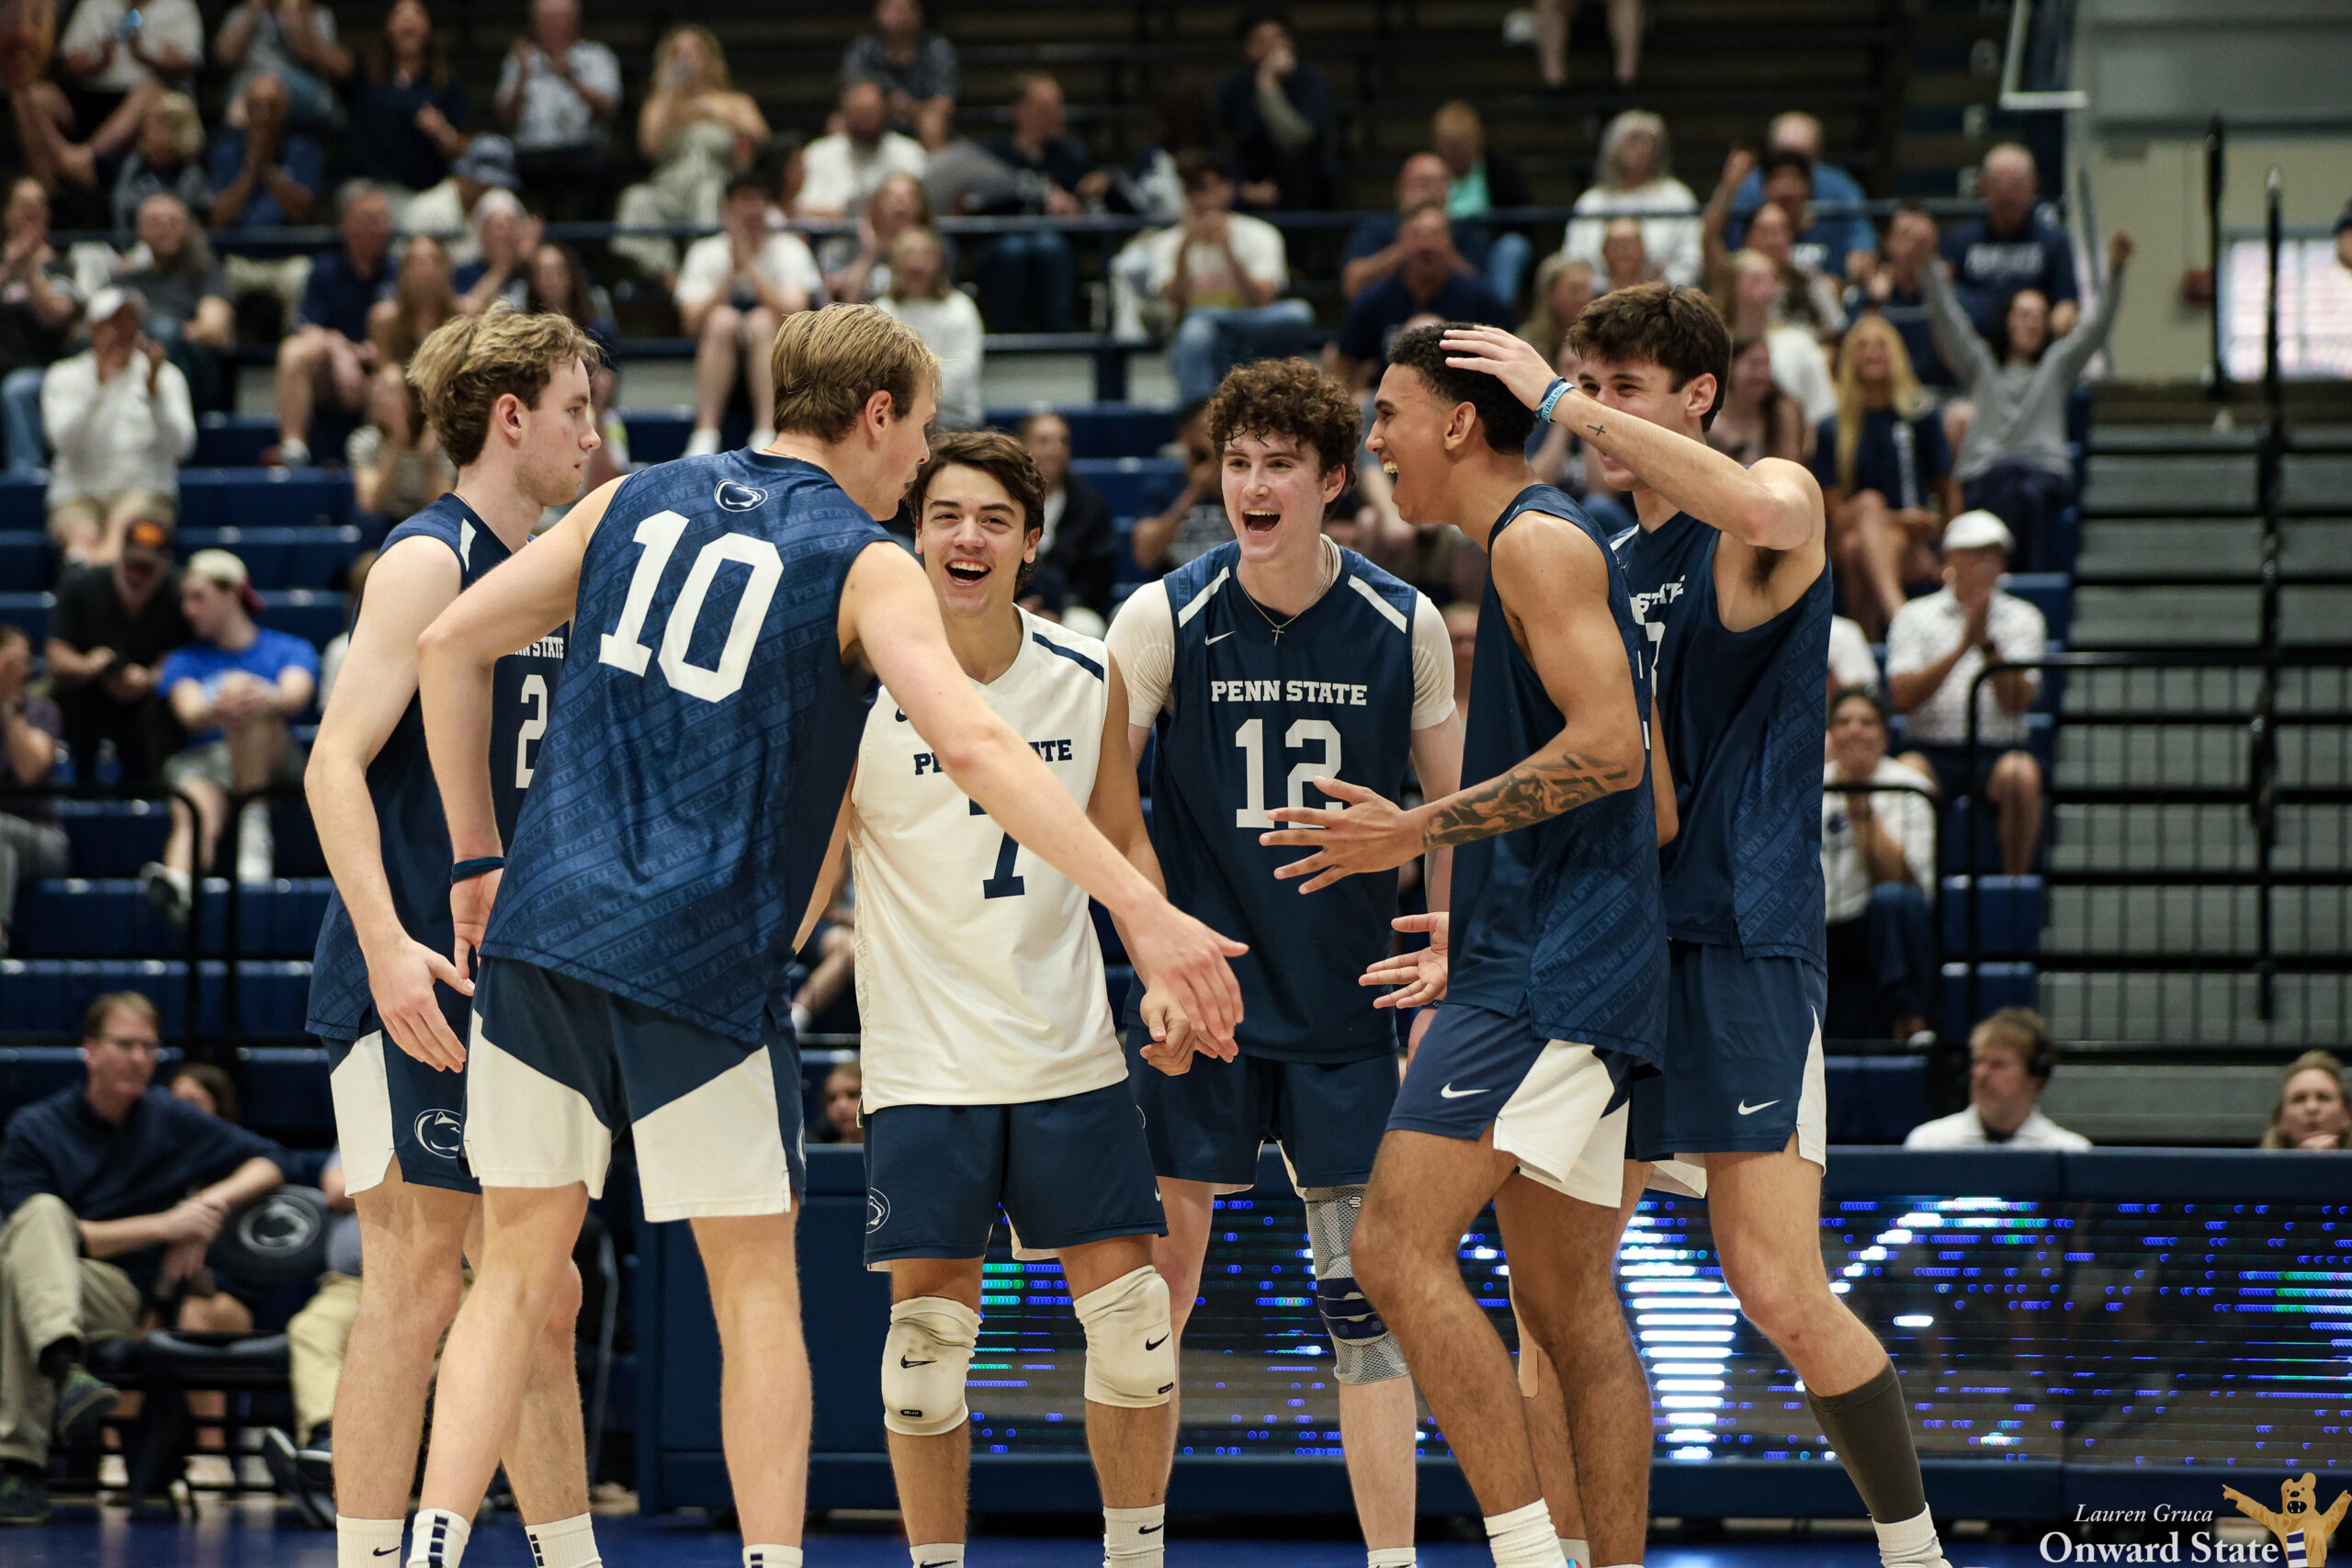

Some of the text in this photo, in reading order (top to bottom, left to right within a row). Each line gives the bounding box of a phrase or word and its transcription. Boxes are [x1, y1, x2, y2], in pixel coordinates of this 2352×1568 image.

[598, 509, 785, 705] 10
[515, 674, 548, 788] 2
[1211, 680, 1368, 705] PENN STATE
[1236, 718, 1343, 829] 12
